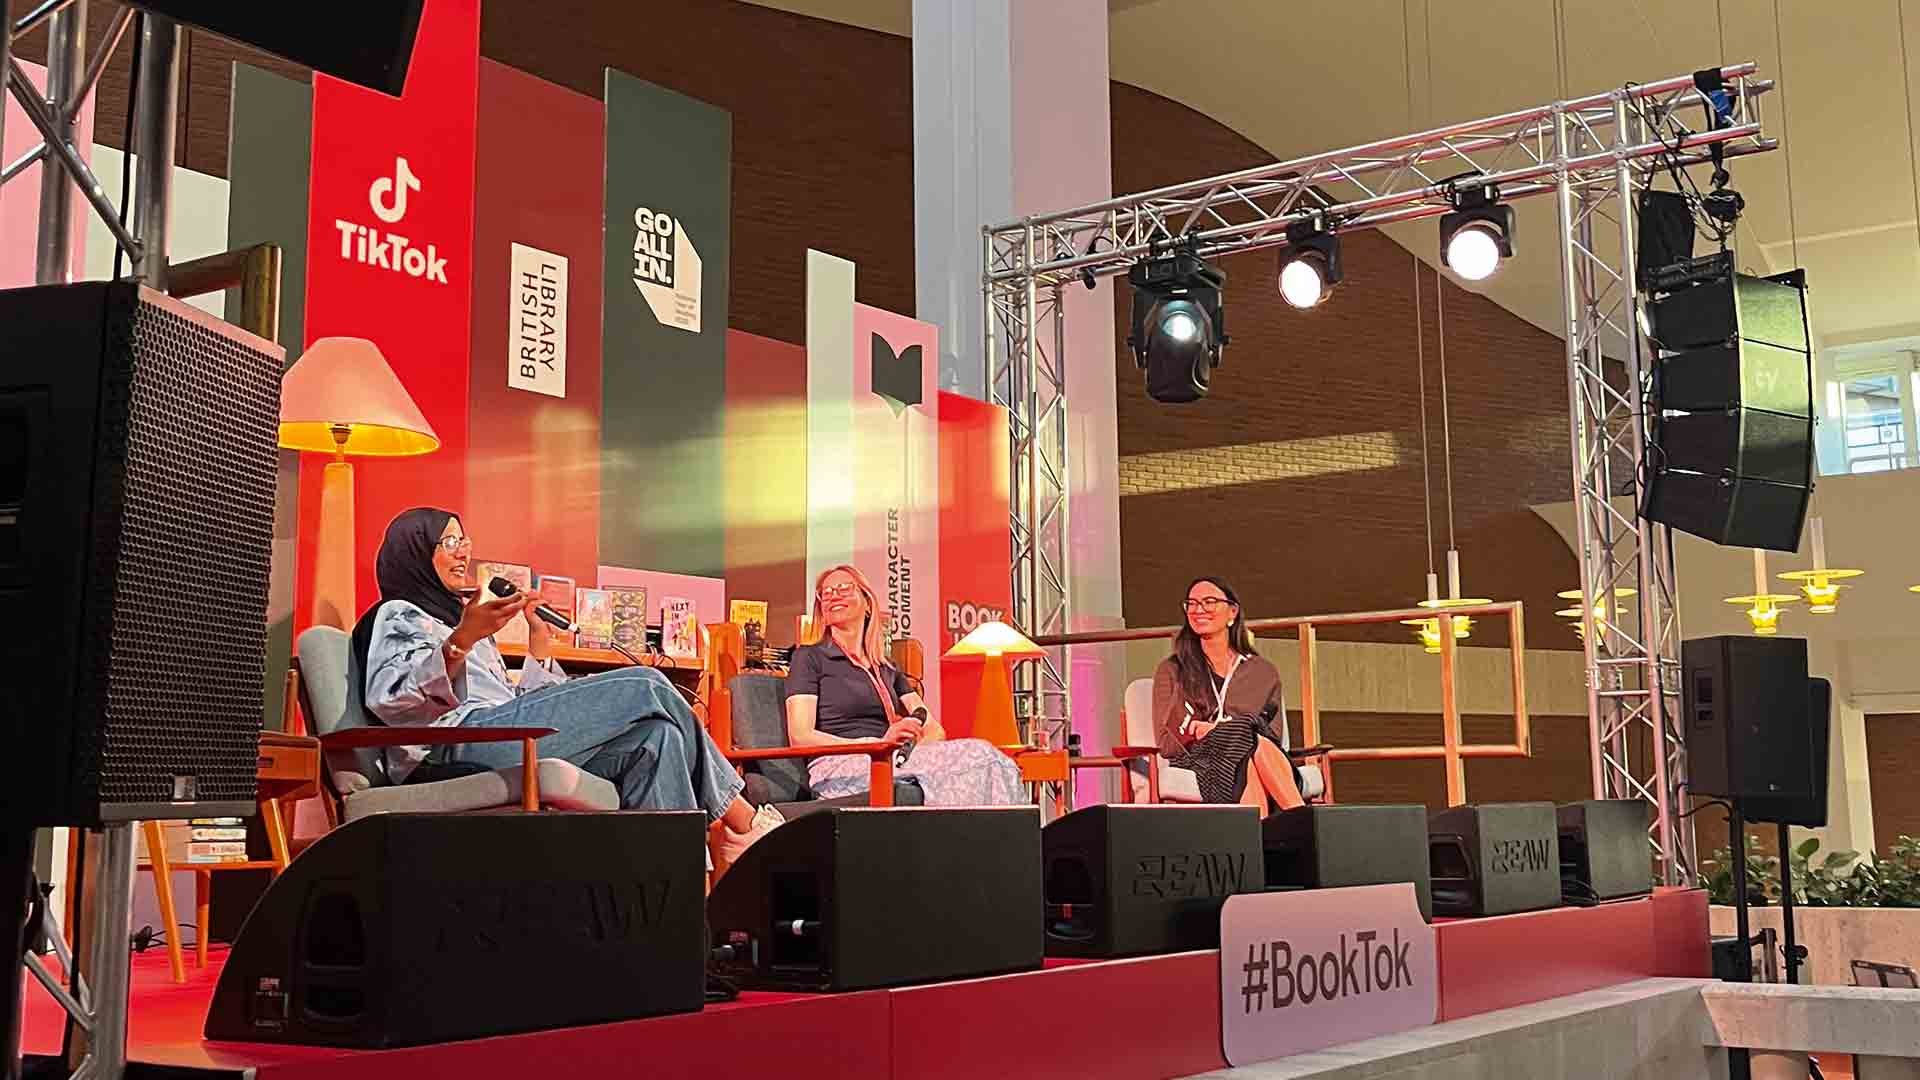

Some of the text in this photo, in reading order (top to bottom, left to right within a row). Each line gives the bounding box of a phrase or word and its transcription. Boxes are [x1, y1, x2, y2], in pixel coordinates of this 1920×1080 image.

[335, 219, 449, 285] TikTok
[633, 230, 673, 261] ALL
[634, 207, 673, 237] GO
[633, 252, 672, 284] IN.
[520, 271, 539, 380] BRITISH
[538, 263, 558, 373] LIBRARY
[887, 507, 899, 636] CHARACTER
[1240, 927, 1415, 1015] #BookTok
